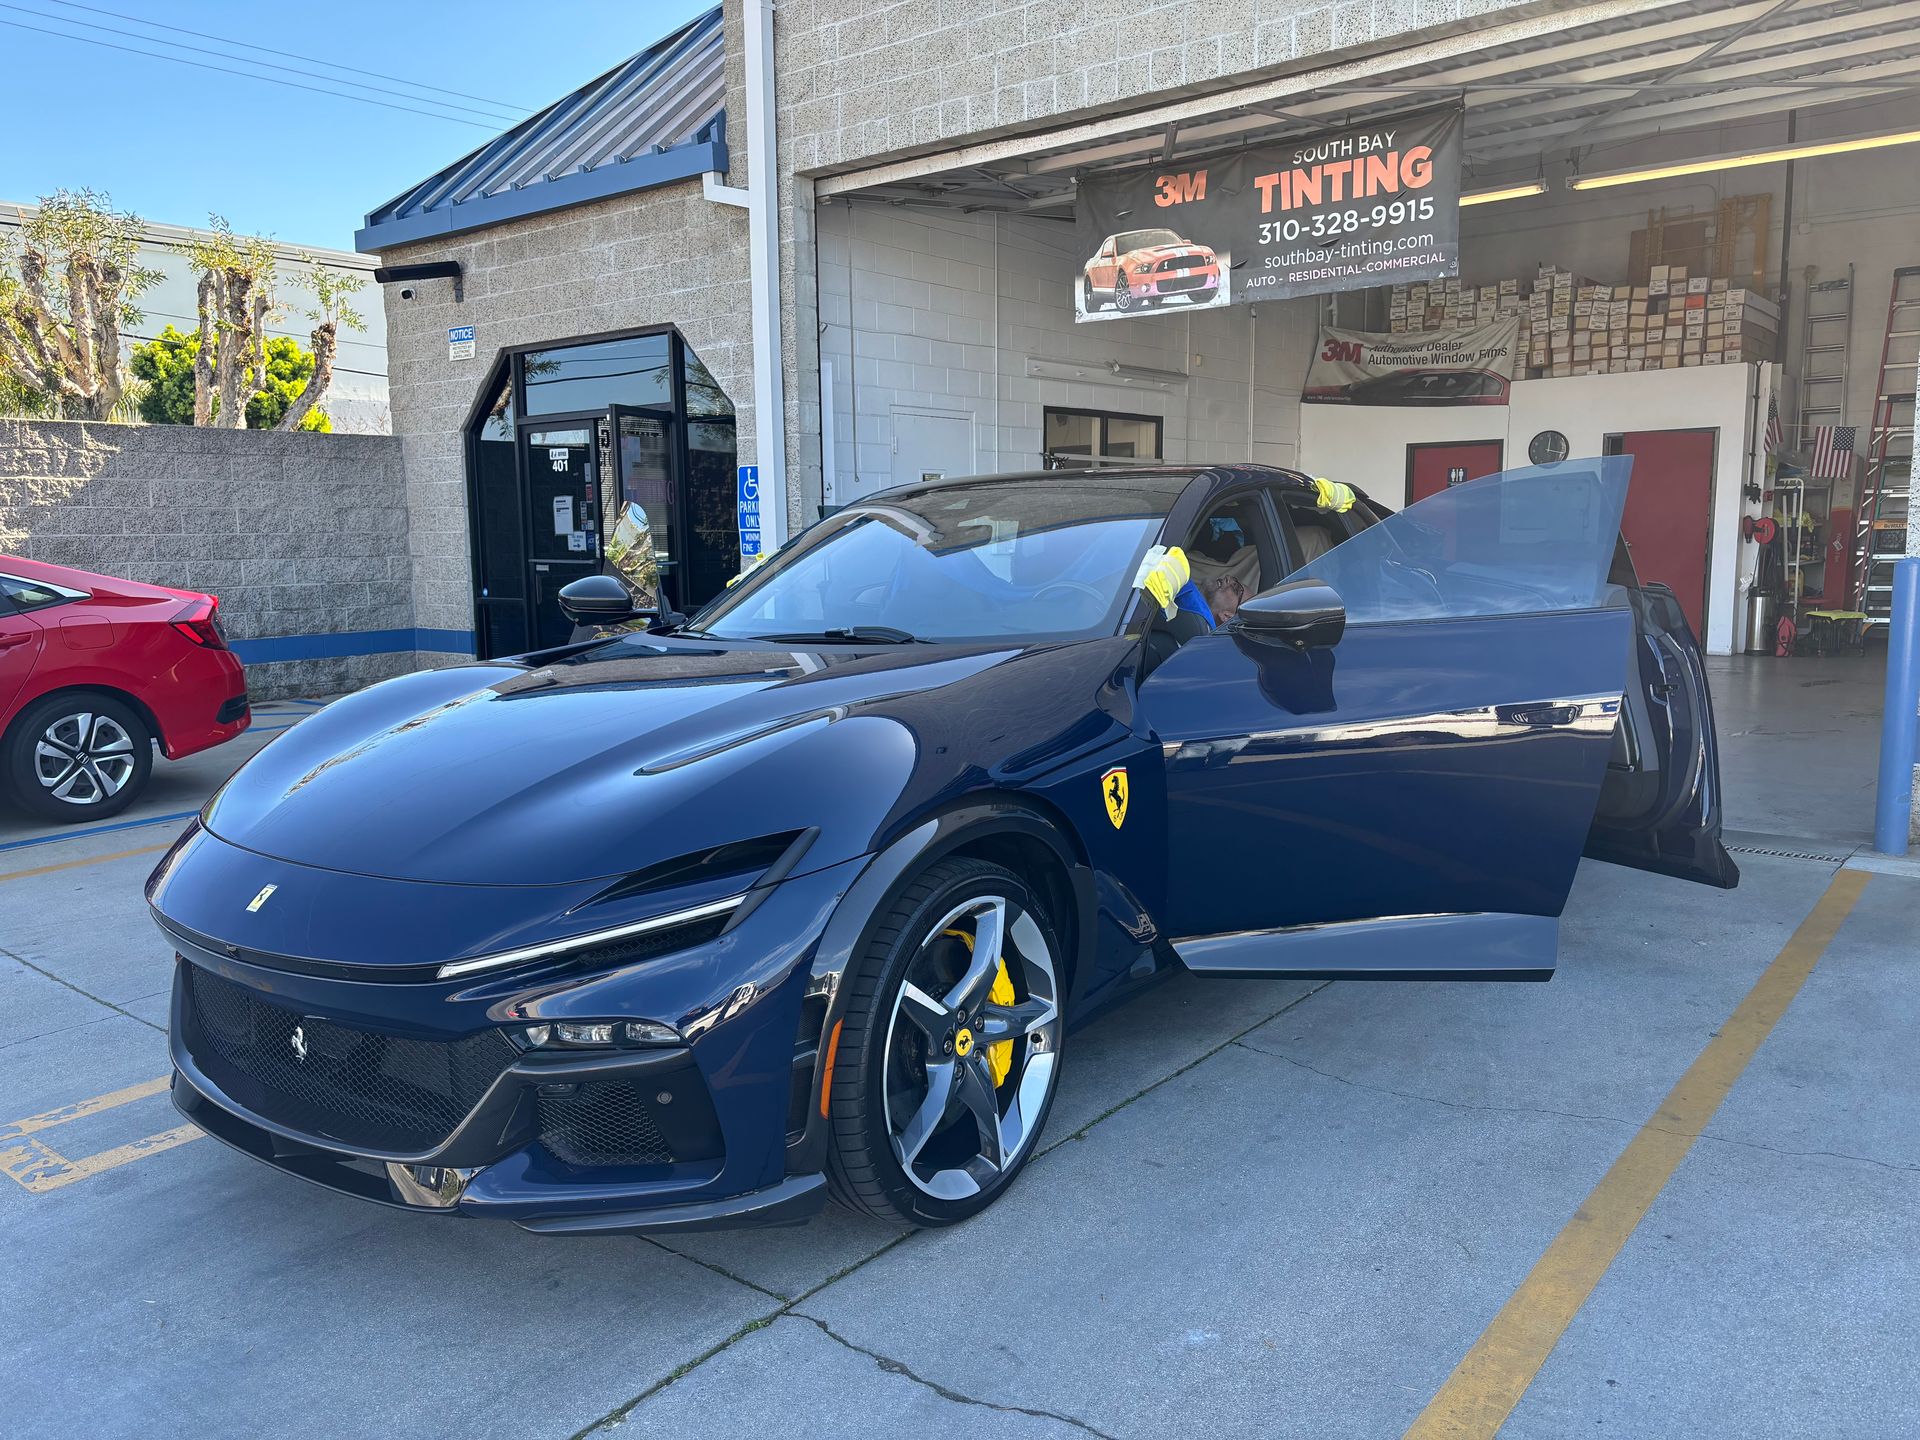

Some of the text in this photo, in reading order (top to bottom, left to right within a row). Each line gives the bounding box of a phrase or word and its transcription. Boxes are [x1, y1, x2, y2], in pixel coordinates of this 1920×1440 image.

[1292, 130, 1397, 165] SOUTH BAY
[1155, 170, 1208, 207] 3M
[1254, 145, 1433, 214] TINTING
[1258, 196, 1434, 245] 310-328-9915
[1264, 233, 1434, 269] southbay-tinting.com
[1246, 275, 1276, 288] AUTO
[1288, 252, 1445, 283] RESIDENTIAL-COMMERCIAL
[450, 328, 473, 341] NOTICE
[1369, 340, 1463, 354] Authorized Dealer
[1321, 339, 1364, 365] 3M
[1368, 347, 1508, 366] Automotive Window Films
[552, 459, 568, 472] 401
[740, 501, 759, 513] PARKI
